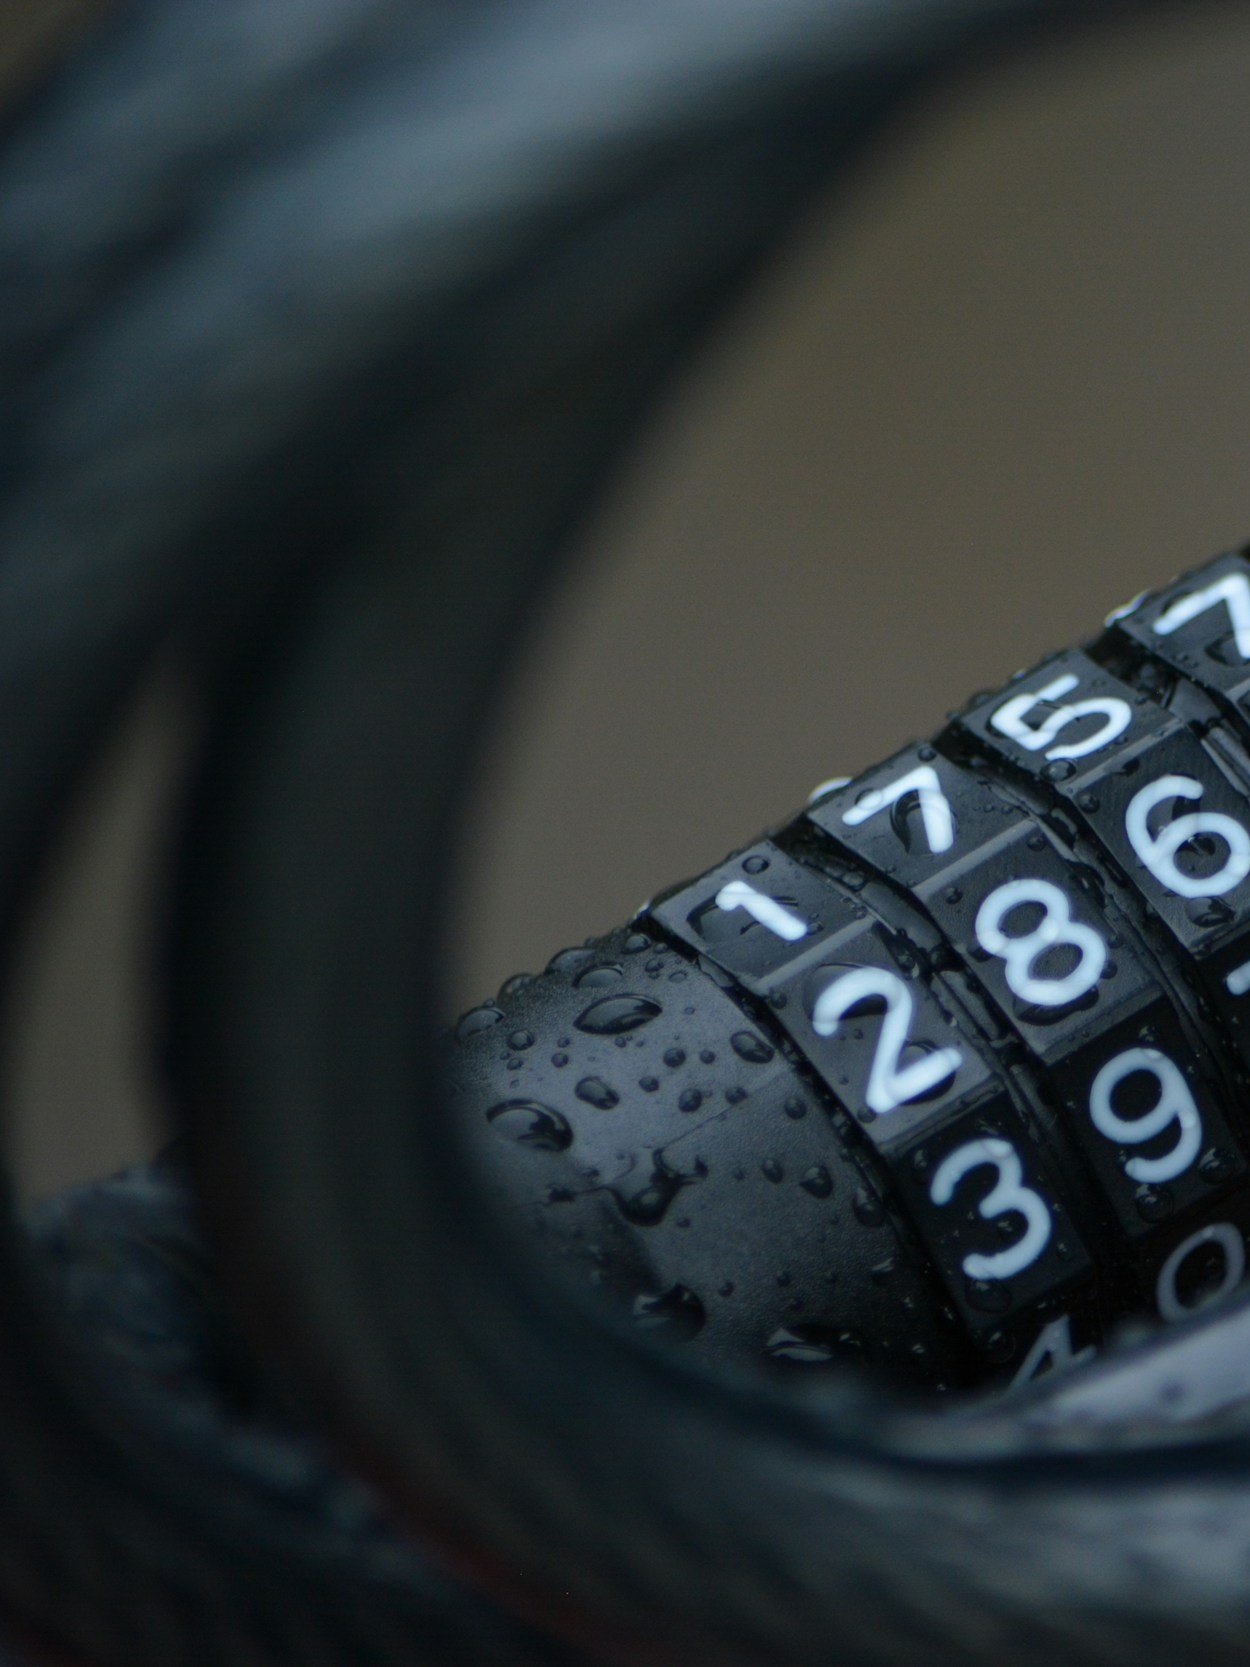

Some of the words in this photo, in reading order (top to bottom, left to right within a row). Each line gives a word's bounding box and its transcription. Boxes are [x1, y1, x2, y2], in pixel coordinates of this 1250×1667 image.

[714, 878, 809, 942] 1
[840, 763, 955, 855] 7
[990, 672, 1133, 762] 5
[811, 965, 965, 1115] 2
[974, 877, 1108, 1007] 8
[930, 1137, 1052, 1280] 3
[1088, 1046, 1203, 1184] 9
